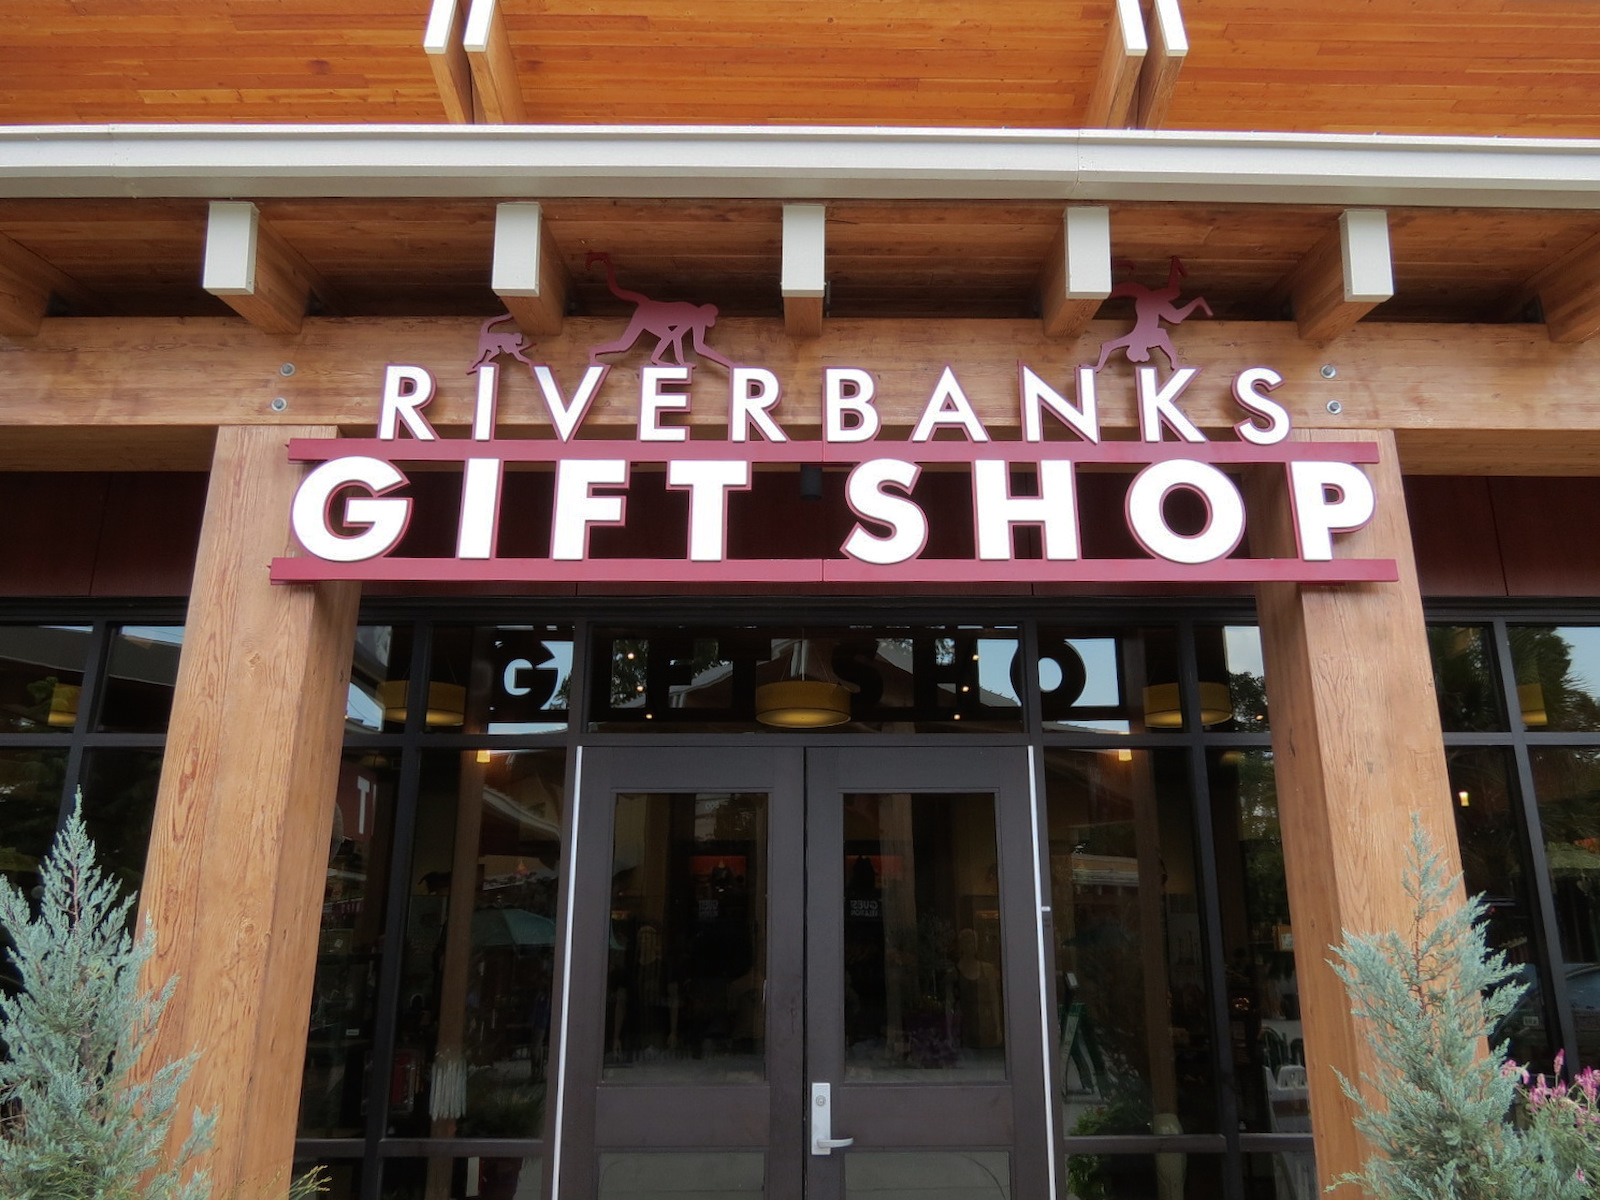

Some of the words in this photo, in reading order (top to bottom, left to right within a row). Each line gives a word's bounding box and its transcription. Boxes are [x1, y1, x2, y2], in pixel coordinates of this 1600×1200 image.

[378, 364, 1292, 445] RIVERBANKS
[291, 455, 752, 563] GIFT
[840, 457, 1377, 566] SHOP
